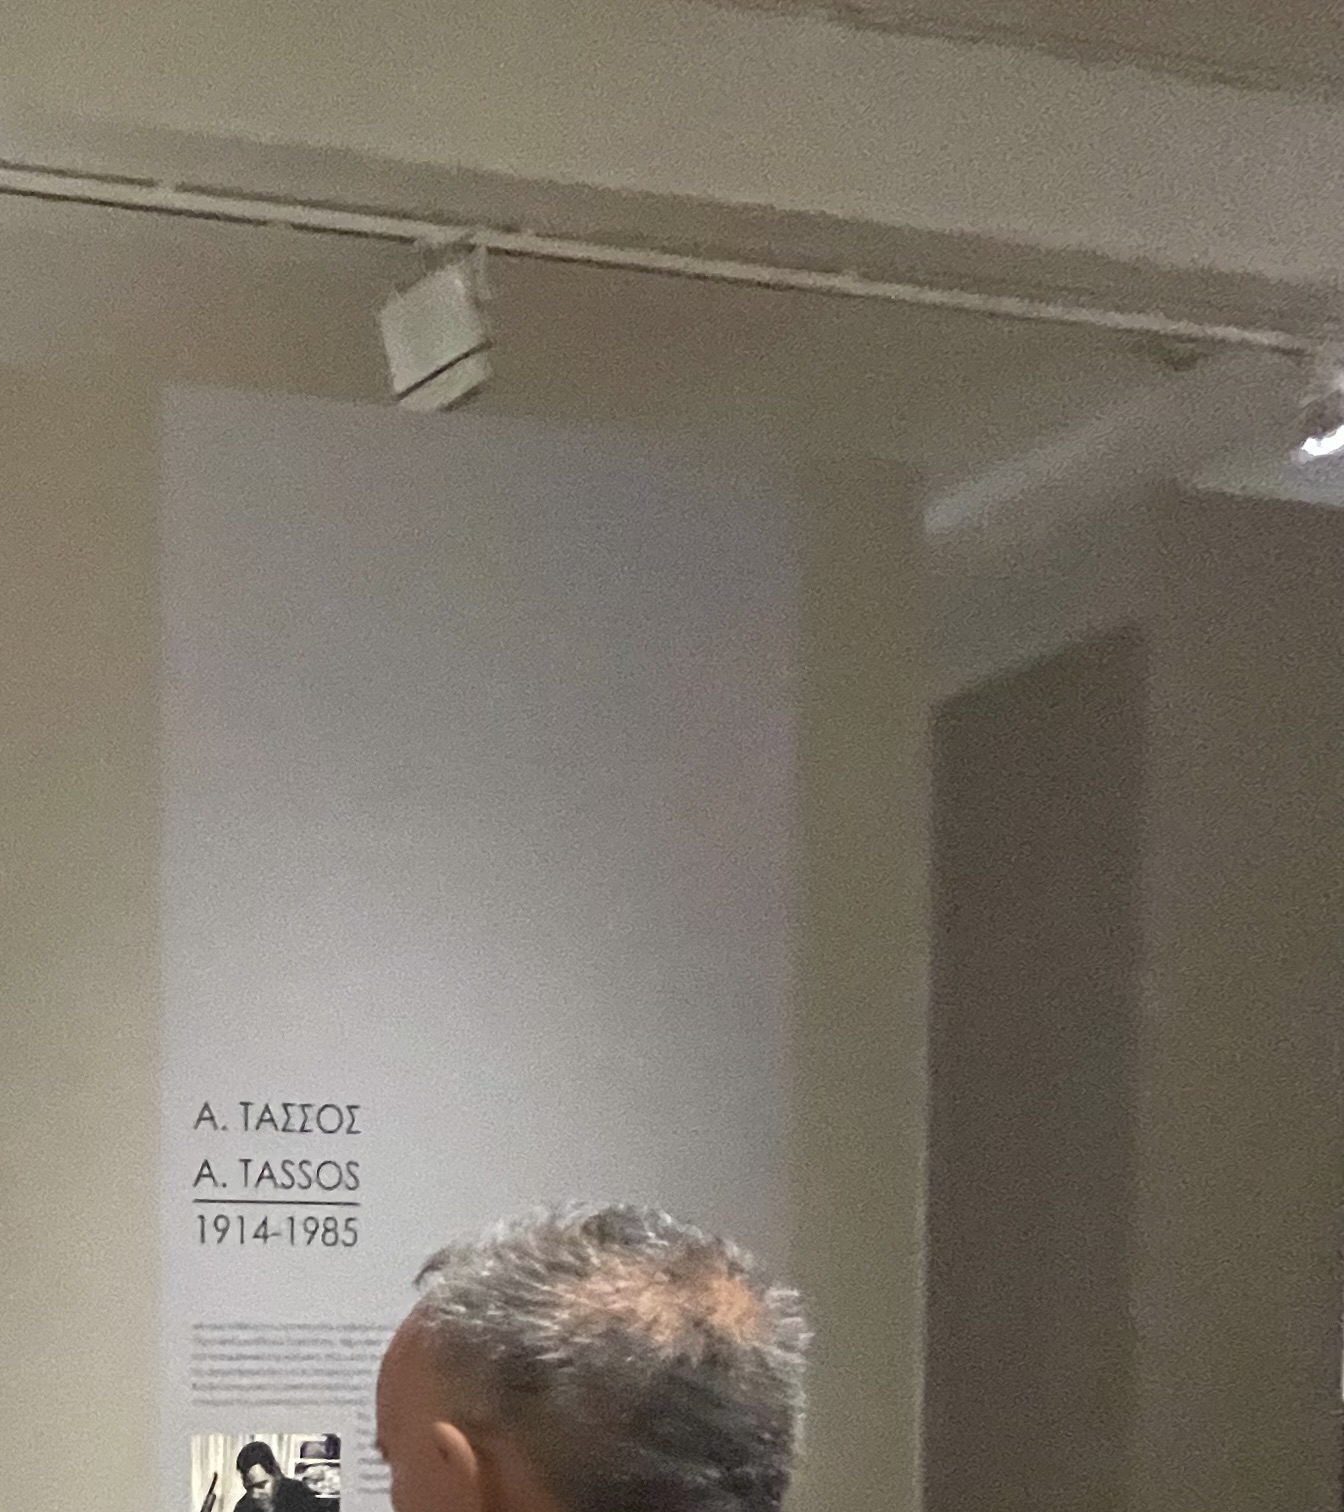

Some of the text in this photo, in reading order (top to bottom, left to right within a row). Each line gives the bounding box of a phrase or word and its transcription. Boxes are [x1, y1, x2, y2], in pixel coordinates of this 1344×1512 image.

[193, 1101, 361, 1134] Α. ΤΑΣΣΟΣ
[193, 1158, 360, 1190] A. TASSOS
[197, 1214, 359, 1247] 1914-1985
